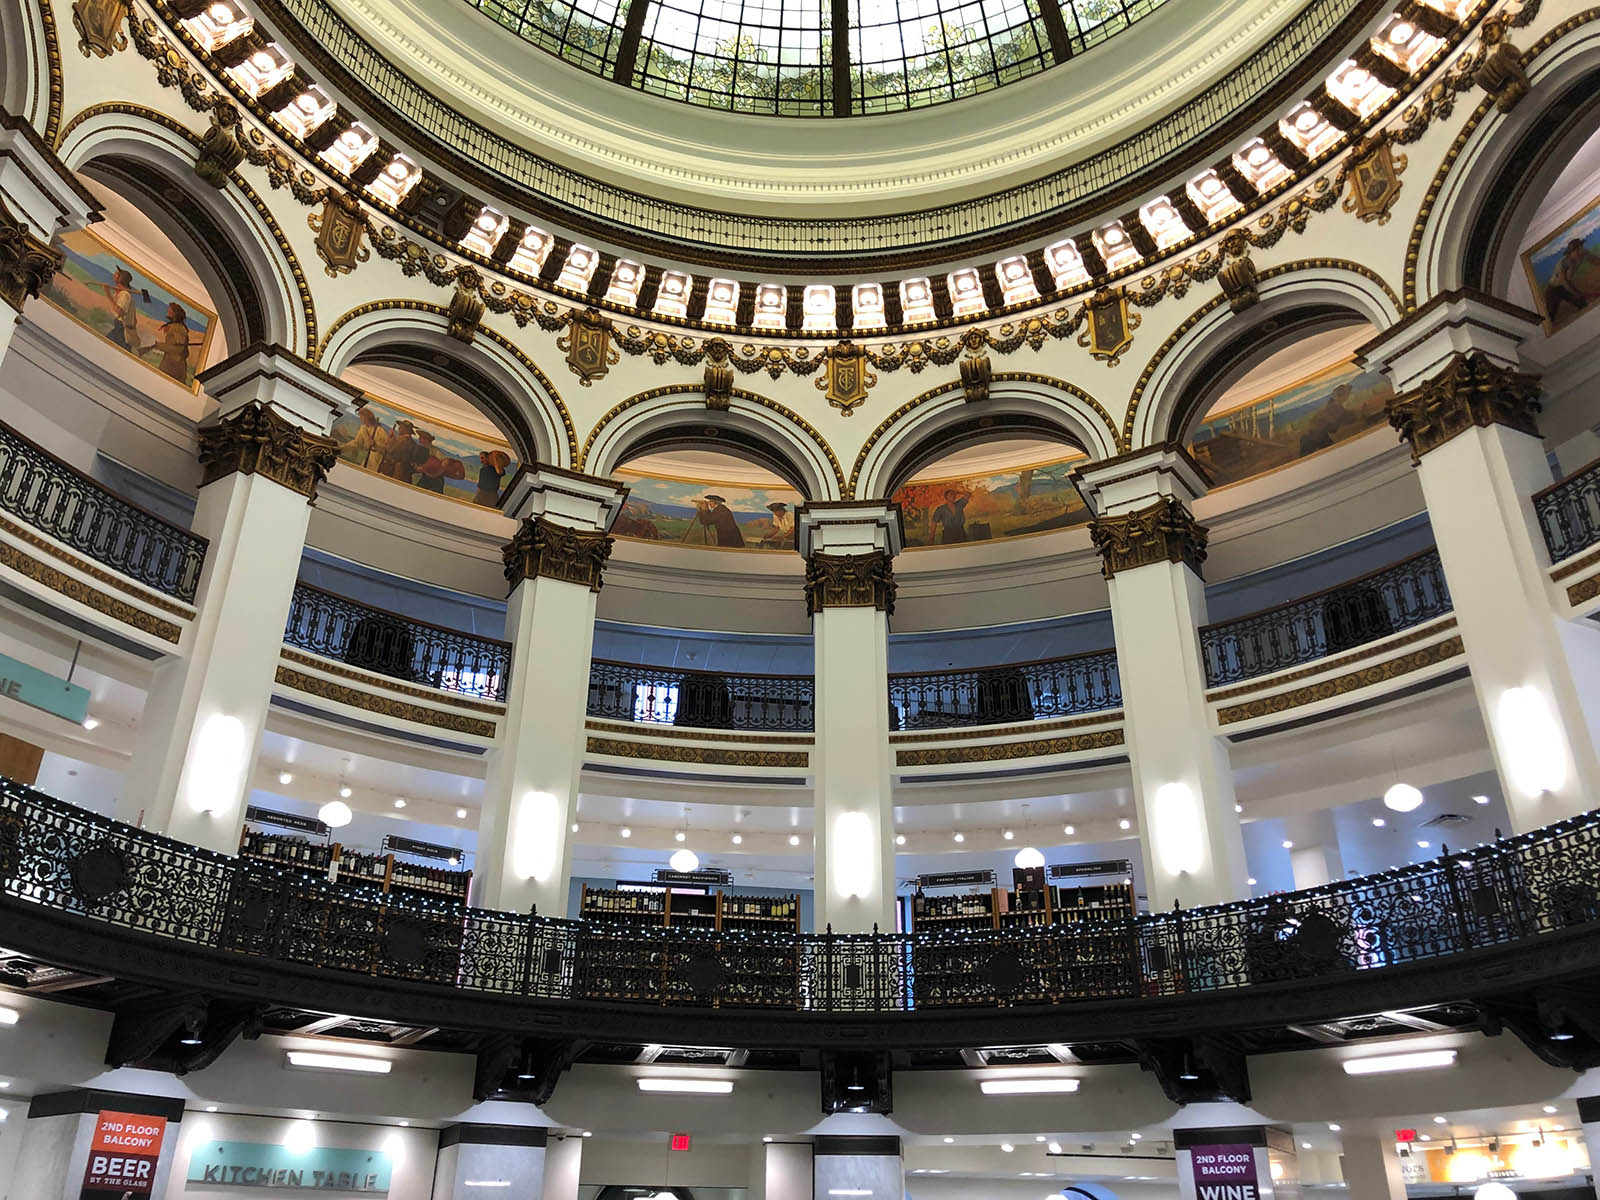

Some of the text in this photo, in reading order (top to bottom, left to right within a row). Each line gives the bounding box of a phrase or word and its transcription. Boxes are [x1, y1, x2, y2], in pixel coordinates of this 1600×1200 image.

[101, 1122, 160, 1136] 2ND FLOOR
[103, 1134, 153, 1147] BALCONY
[1196, 1154, 1250, 1164] 2ND FLOOR
[91, 1156, 151, 1179] BEER
[1201, 1165, 1247, 1175] BALCONY
[89, 1176, 102, 1184] BY
[122, 1180, 148, 1188] GLASS
[202, 1164, 378, 1189] KITCHEN TABLE
[1200, 1185, 1256, 1200] WINE
